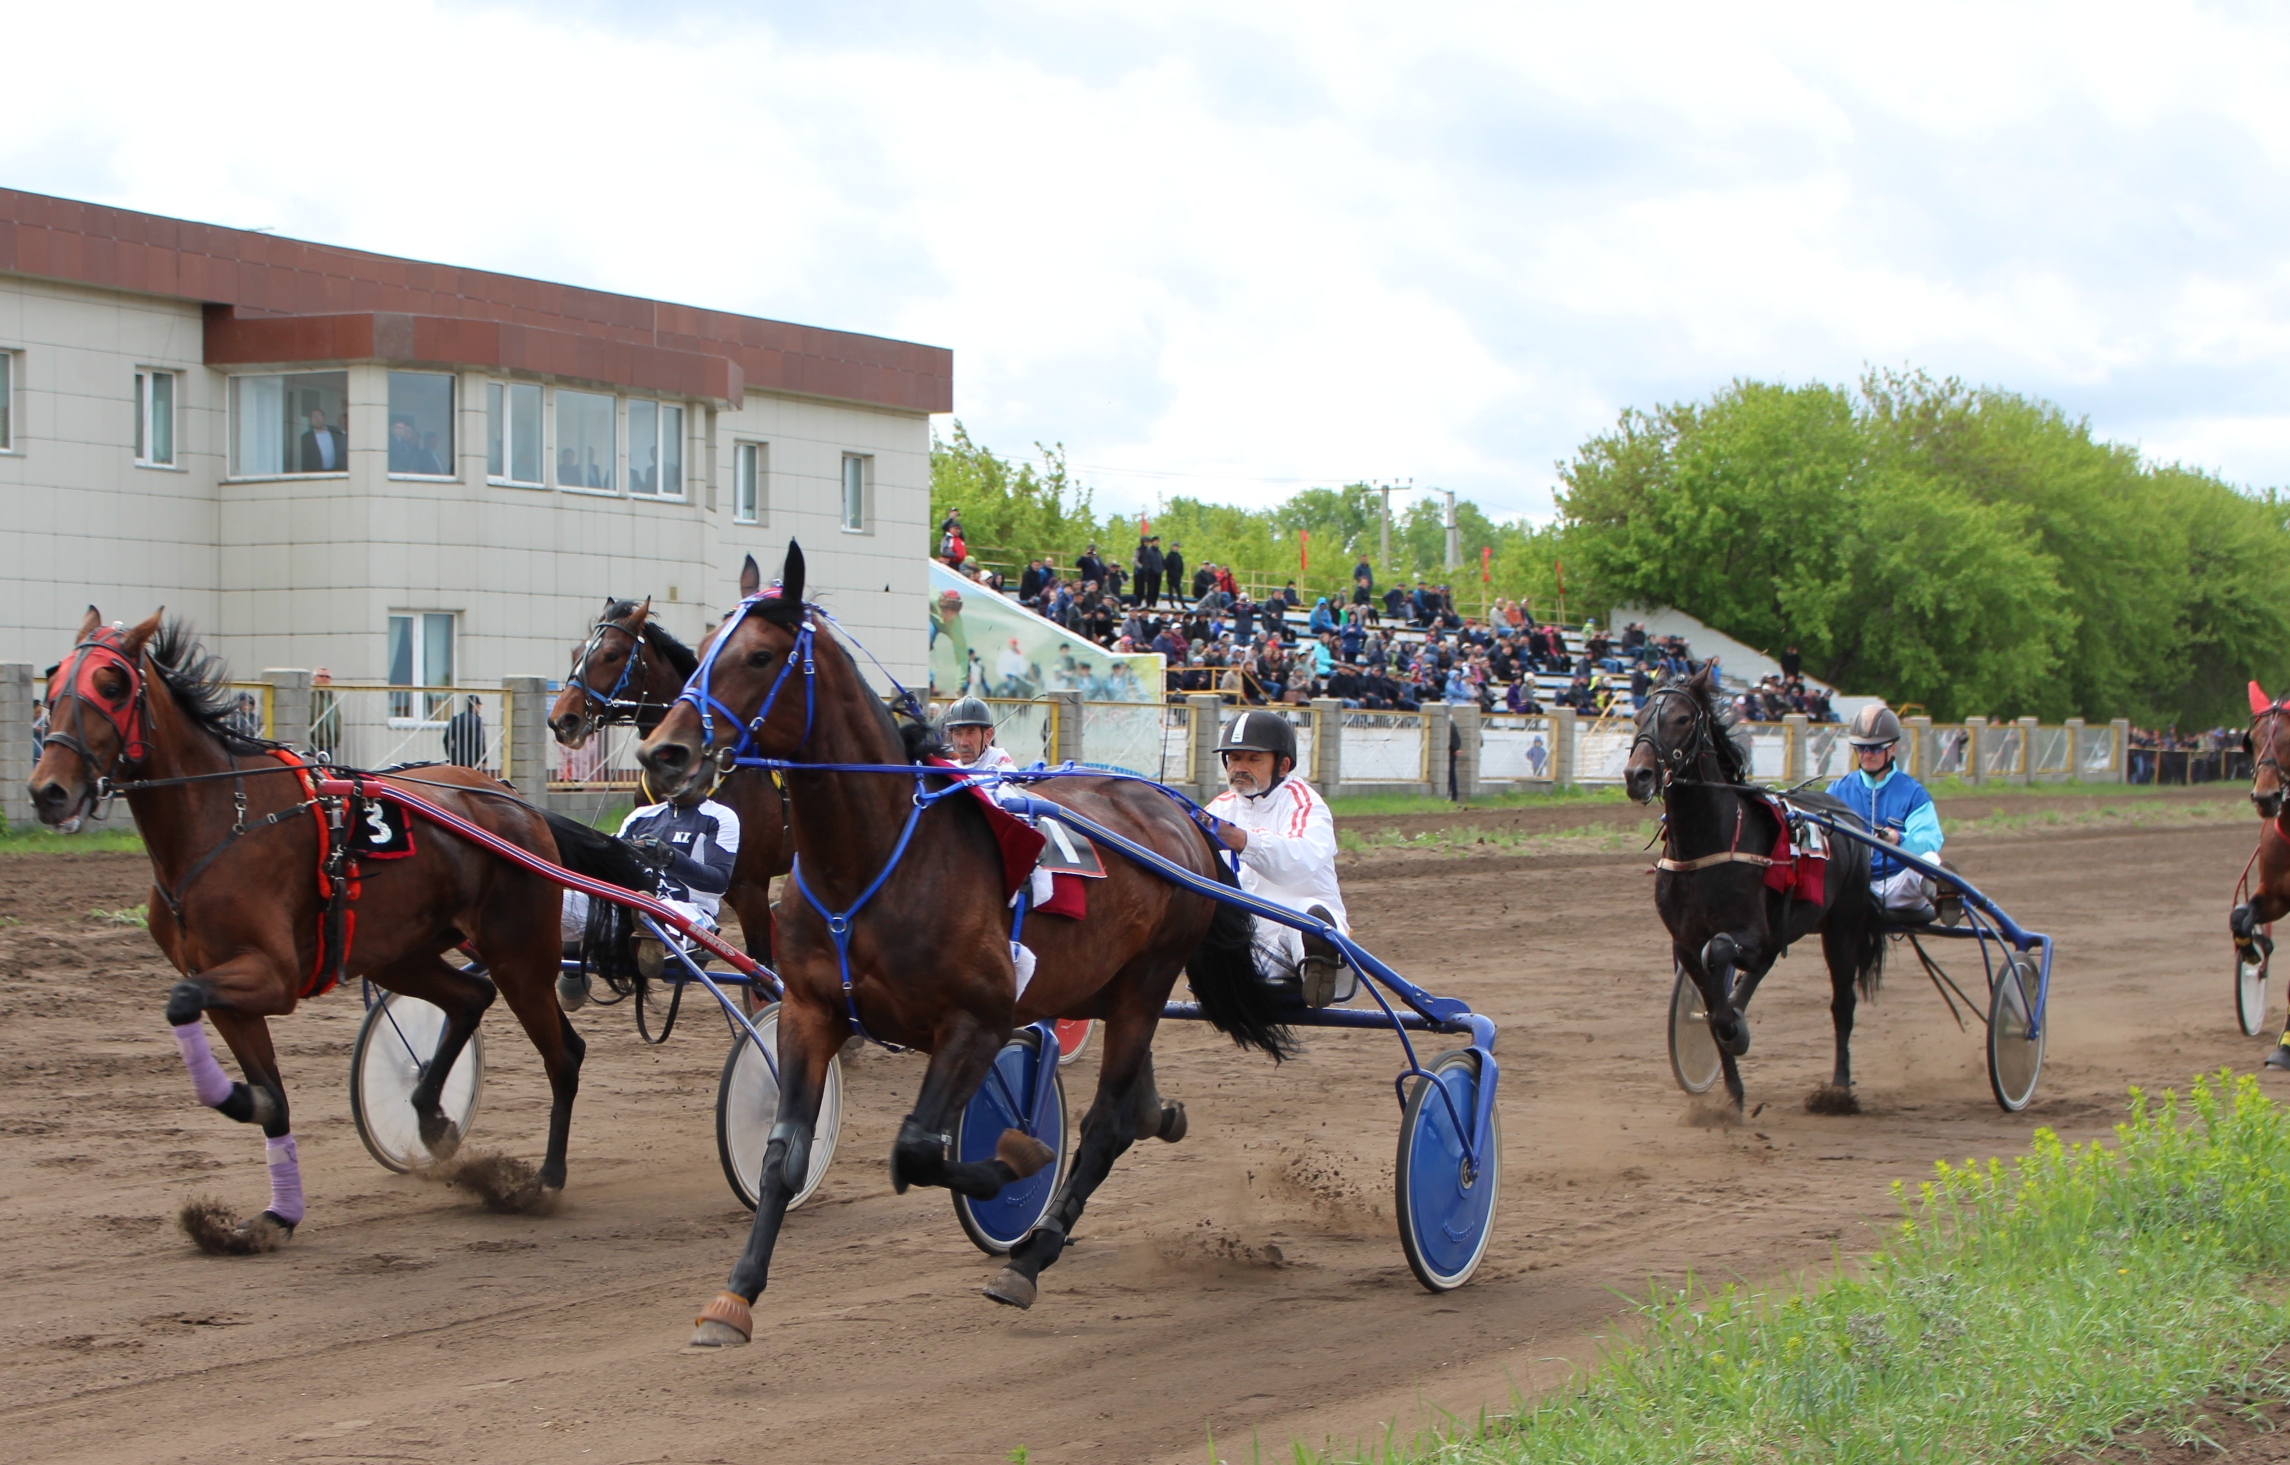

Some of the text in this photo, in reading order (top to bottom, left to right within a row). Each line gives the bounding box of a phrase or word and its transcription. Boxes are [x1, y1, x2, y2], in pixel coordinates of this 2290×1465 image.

[363, 802, 393, 844] 3
[671, 831, 692, 844] KZ
[687, 923, 729, 954] Bavaria
